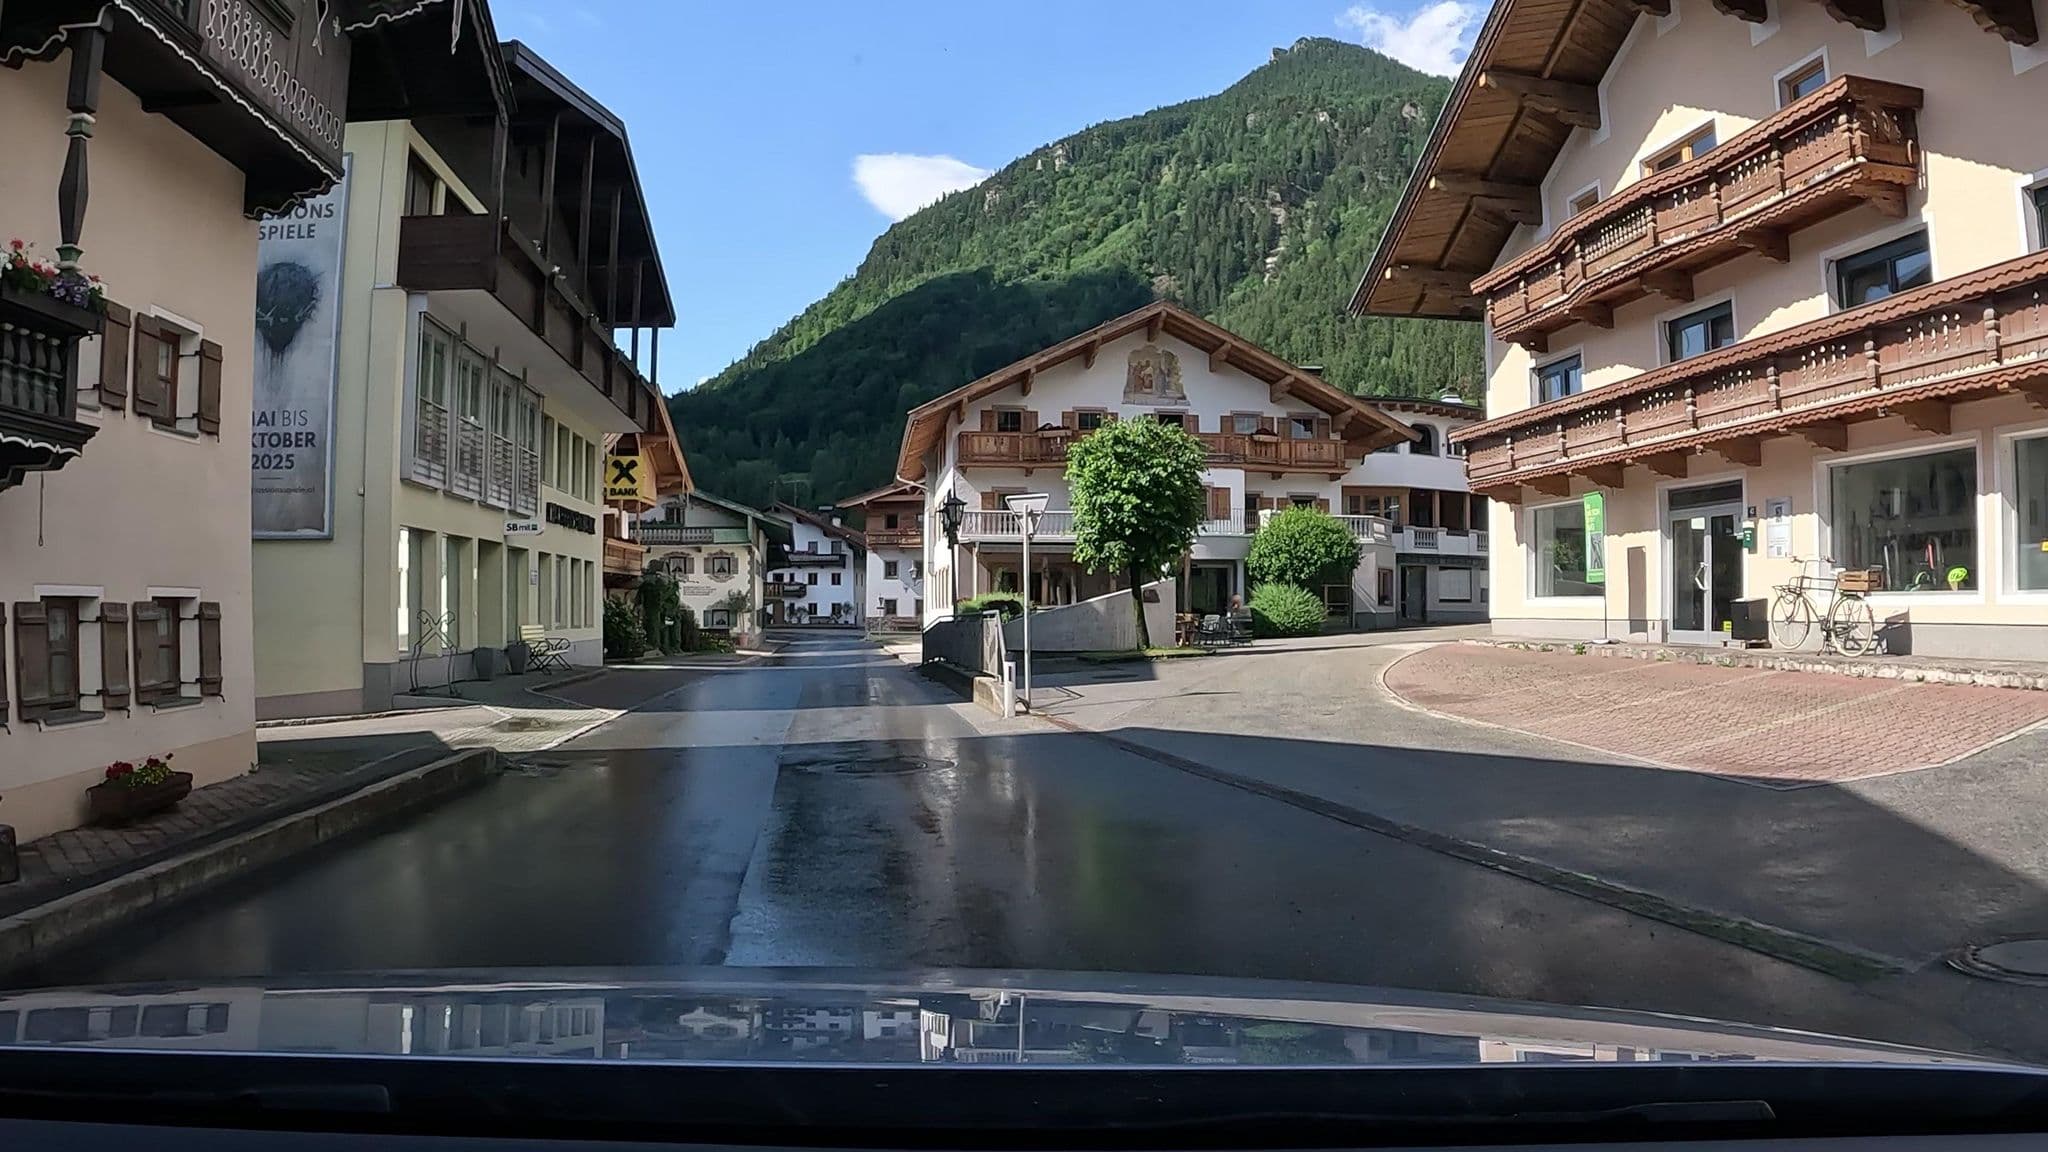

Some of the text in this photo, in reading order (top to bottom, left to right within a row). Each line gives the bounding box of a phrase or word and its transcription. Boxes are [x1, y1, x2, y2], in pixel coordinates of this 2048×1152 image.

[259, 223, 316, 240] SPIELE
[282, 410, 308, 426] BIS
[252, 454, 295, 470] 2025
[610, 487, 639, 497] BANK
[506, 523, 518, 531] SB
